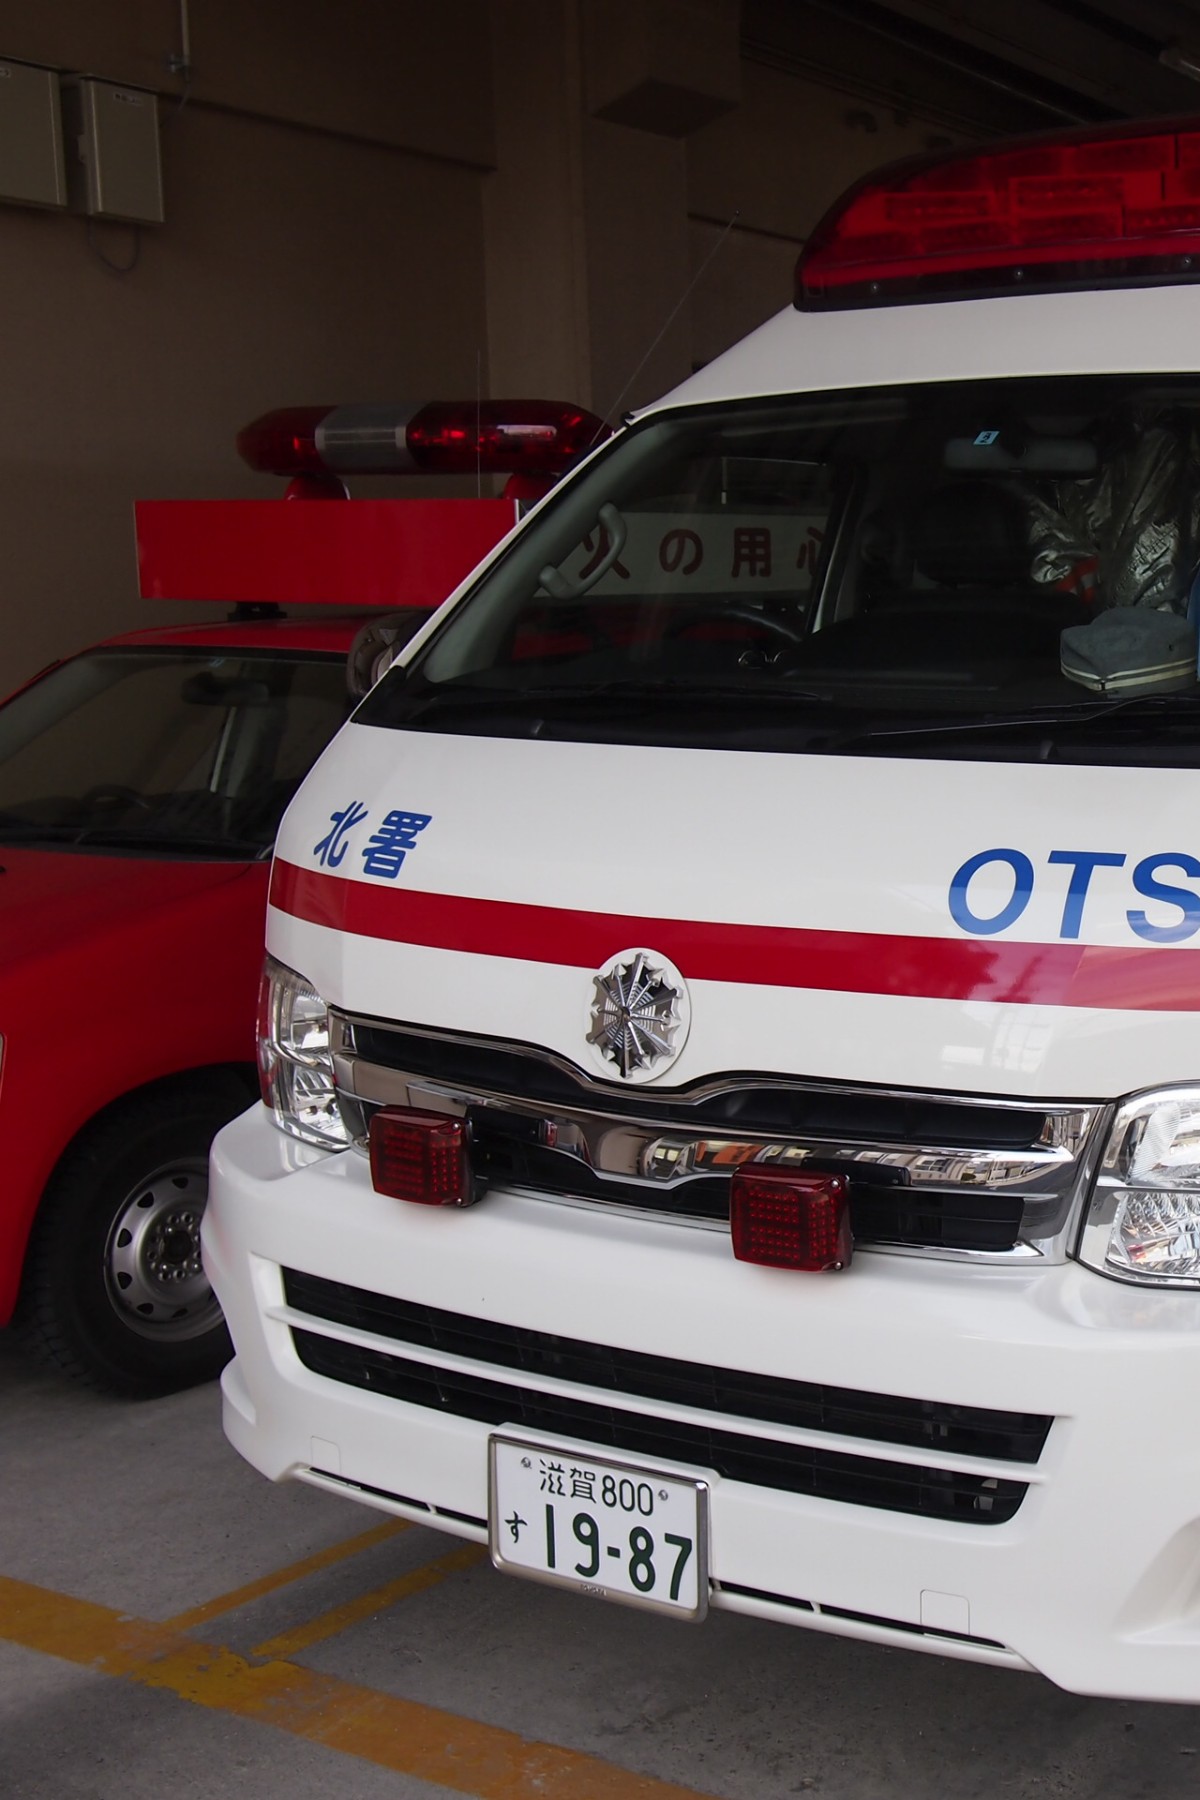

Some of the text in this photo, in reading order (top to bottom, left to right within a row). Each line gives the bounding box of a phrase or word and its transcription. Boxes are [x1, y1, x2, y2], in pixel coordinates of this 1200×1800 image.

[313, 800, 433, 879] 北署
[504, 1503, 693, 1601] す 19-87
